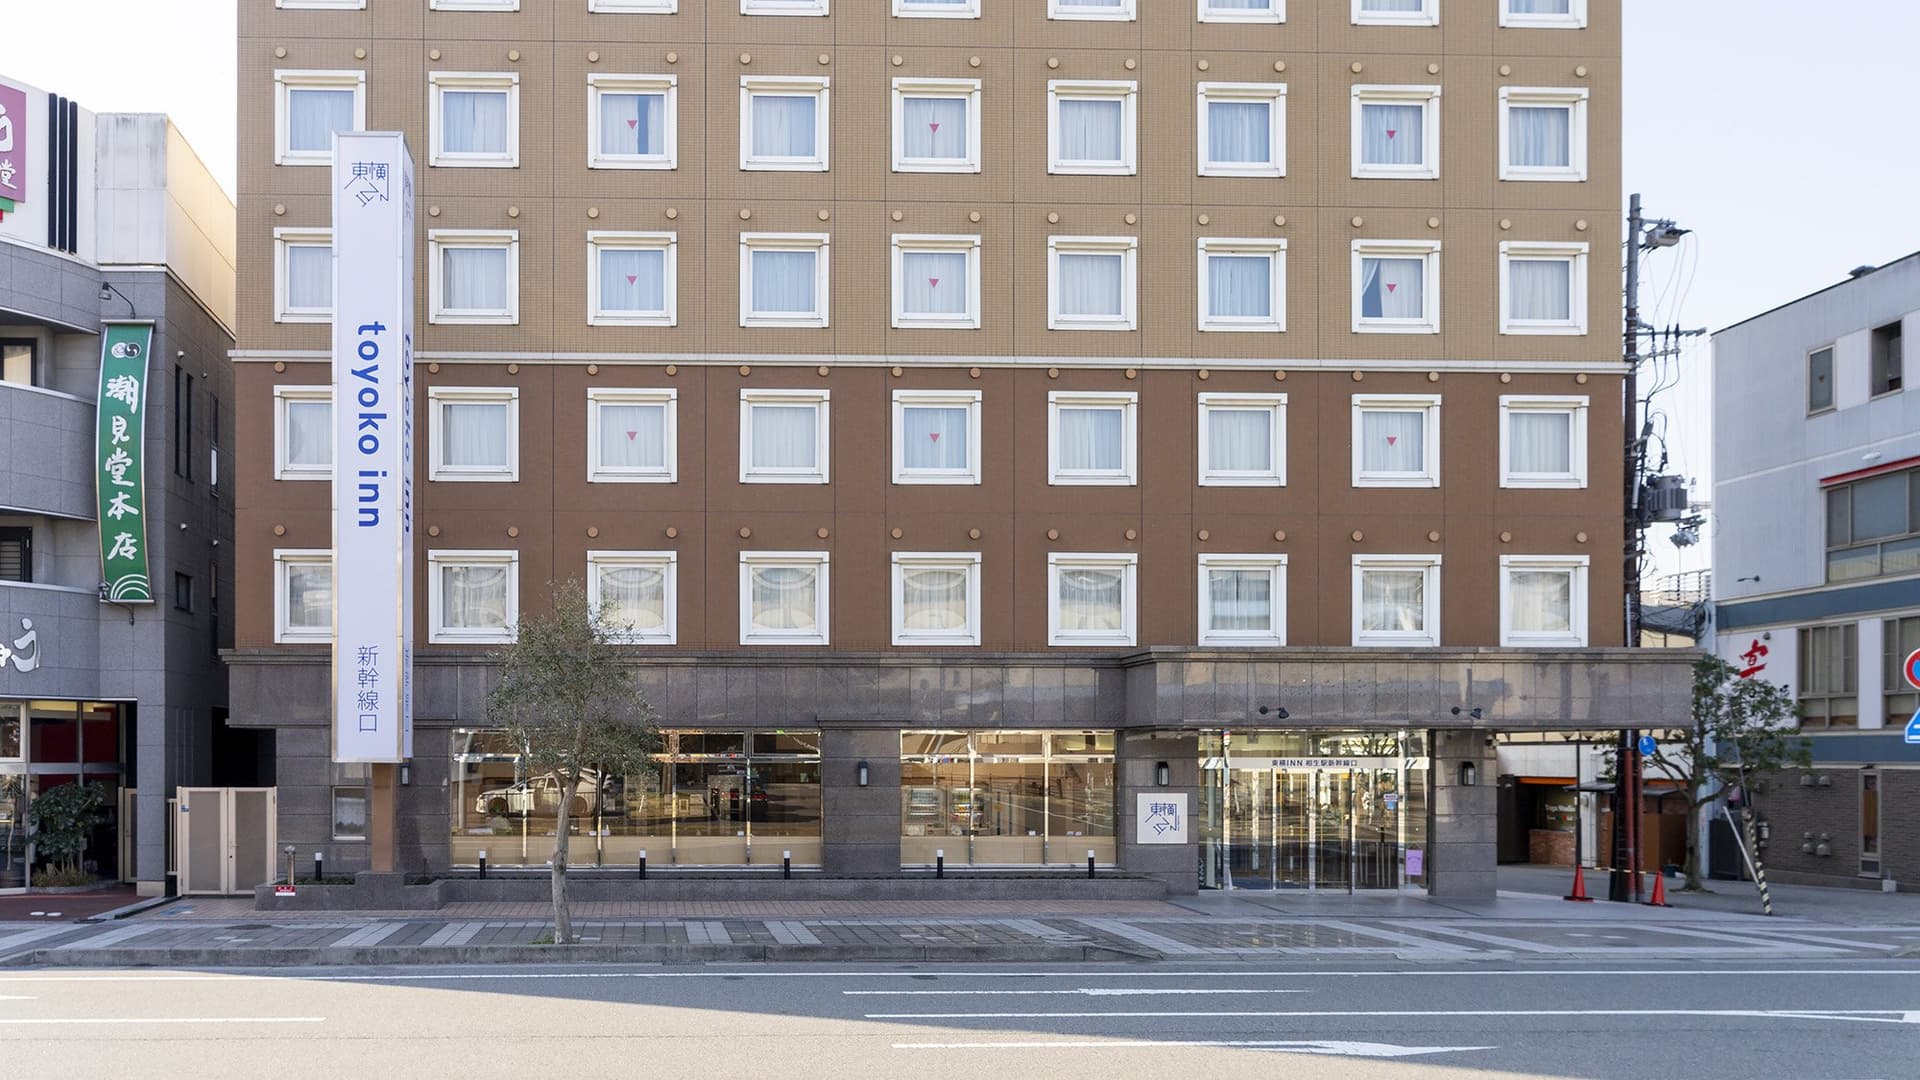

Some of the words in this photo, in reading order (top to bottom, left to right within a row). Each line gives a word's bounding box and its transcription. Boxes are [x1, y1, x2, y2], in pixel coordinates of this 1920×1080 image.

[351, 321, 387, 455] toyoko
[358, 470, 387, 527] inn
[357, 645, 379, 732] 新幹線口
